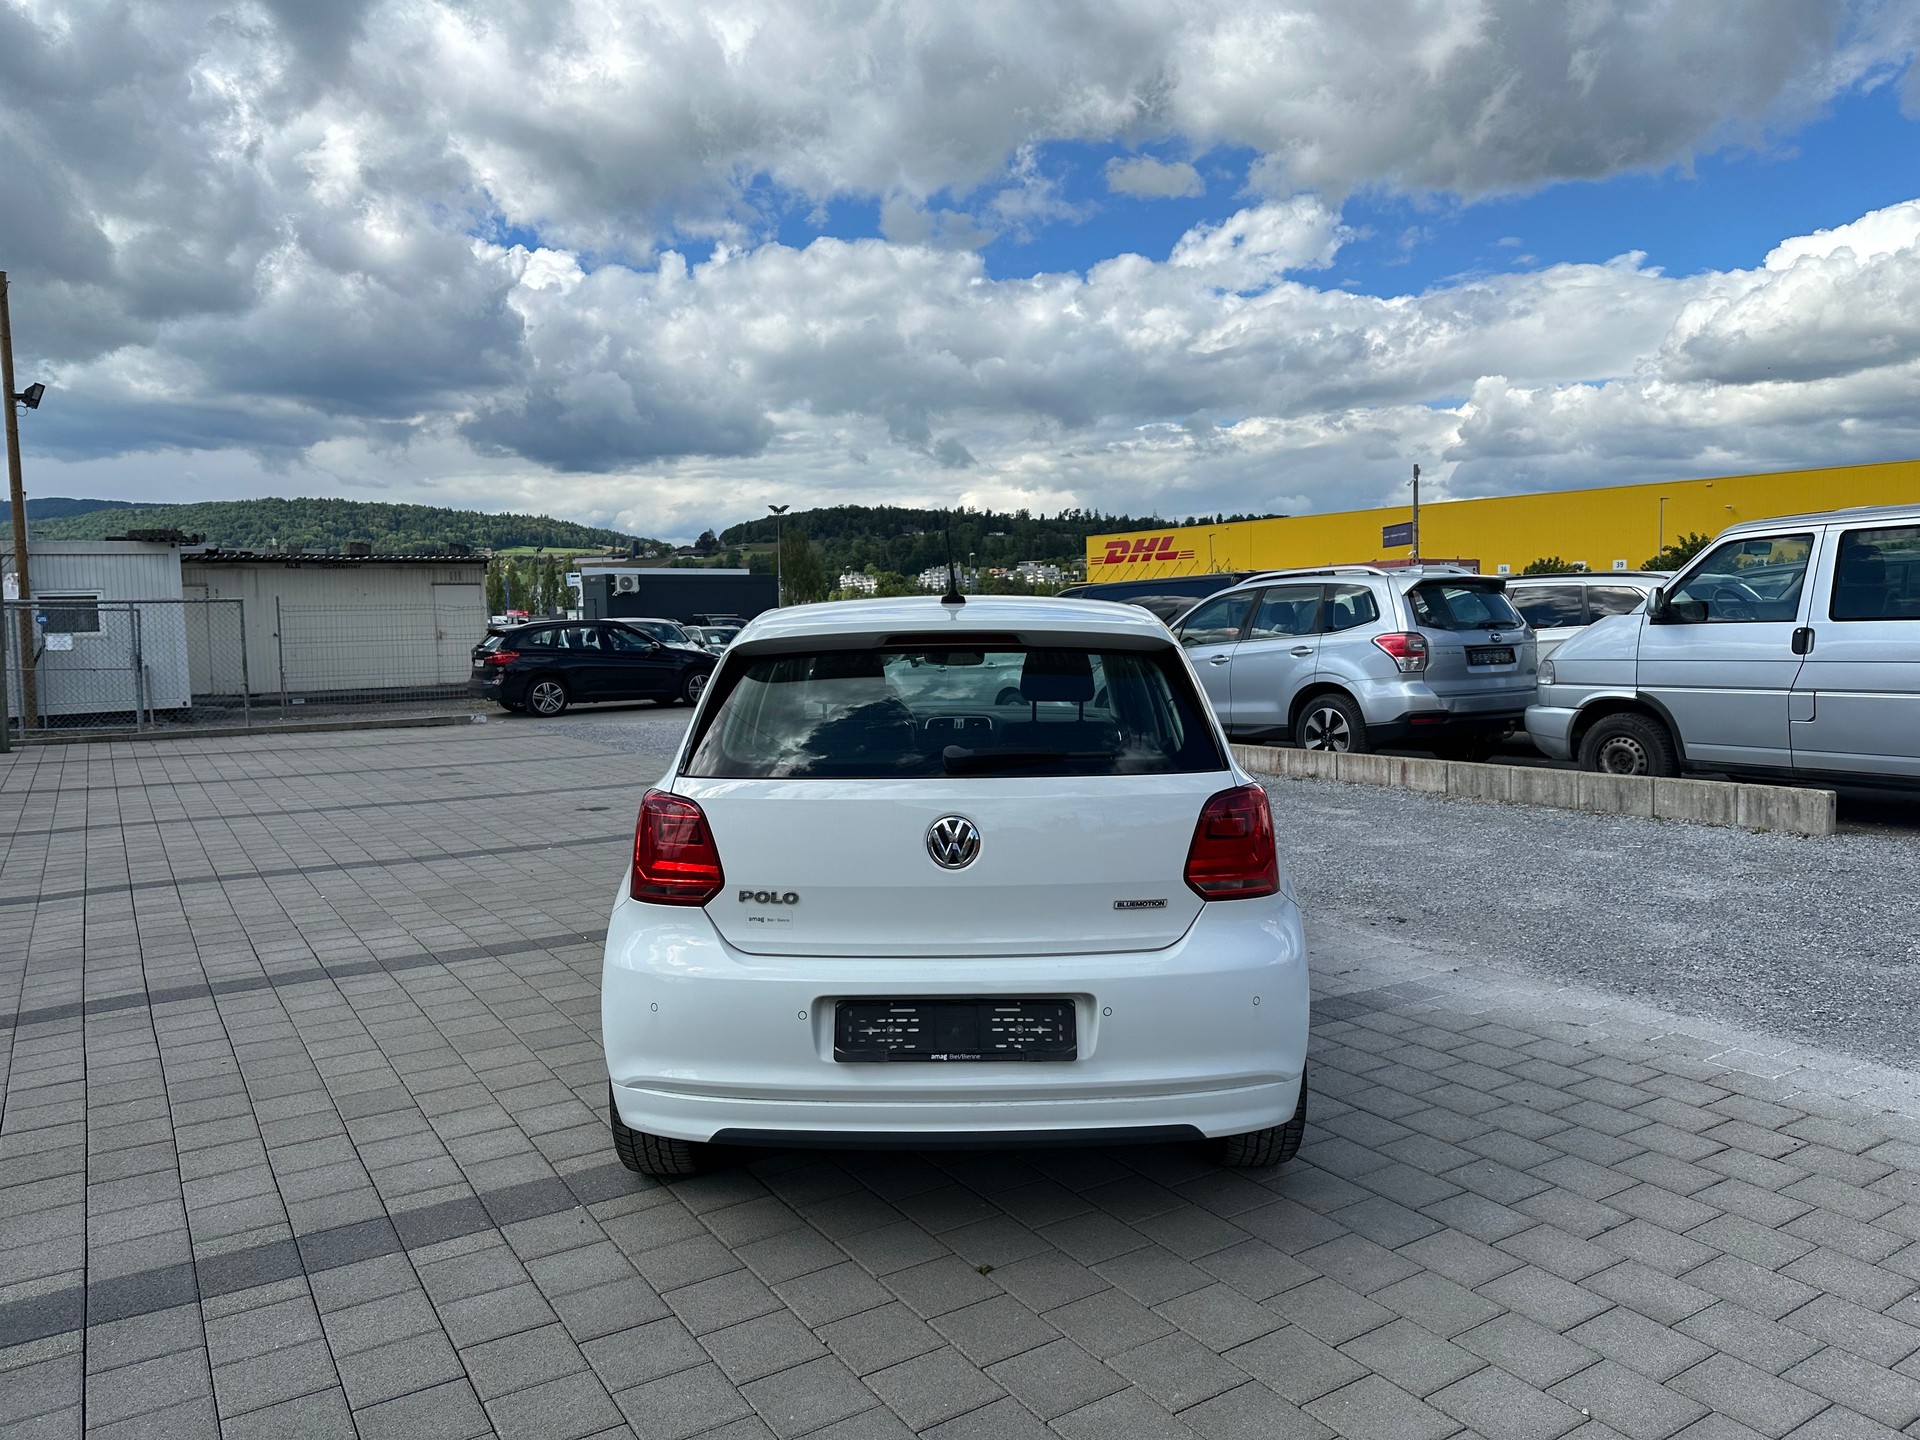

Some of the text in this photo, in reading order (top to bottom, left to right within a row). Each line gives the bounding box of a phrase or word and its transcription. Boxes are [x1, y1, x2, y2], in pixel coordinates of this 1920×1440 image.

[1103, 536, 1180, 564] DHL
[738, 890, 800, 905] POLO
[1117, 900, 1165, 908] BLUEMOTION
